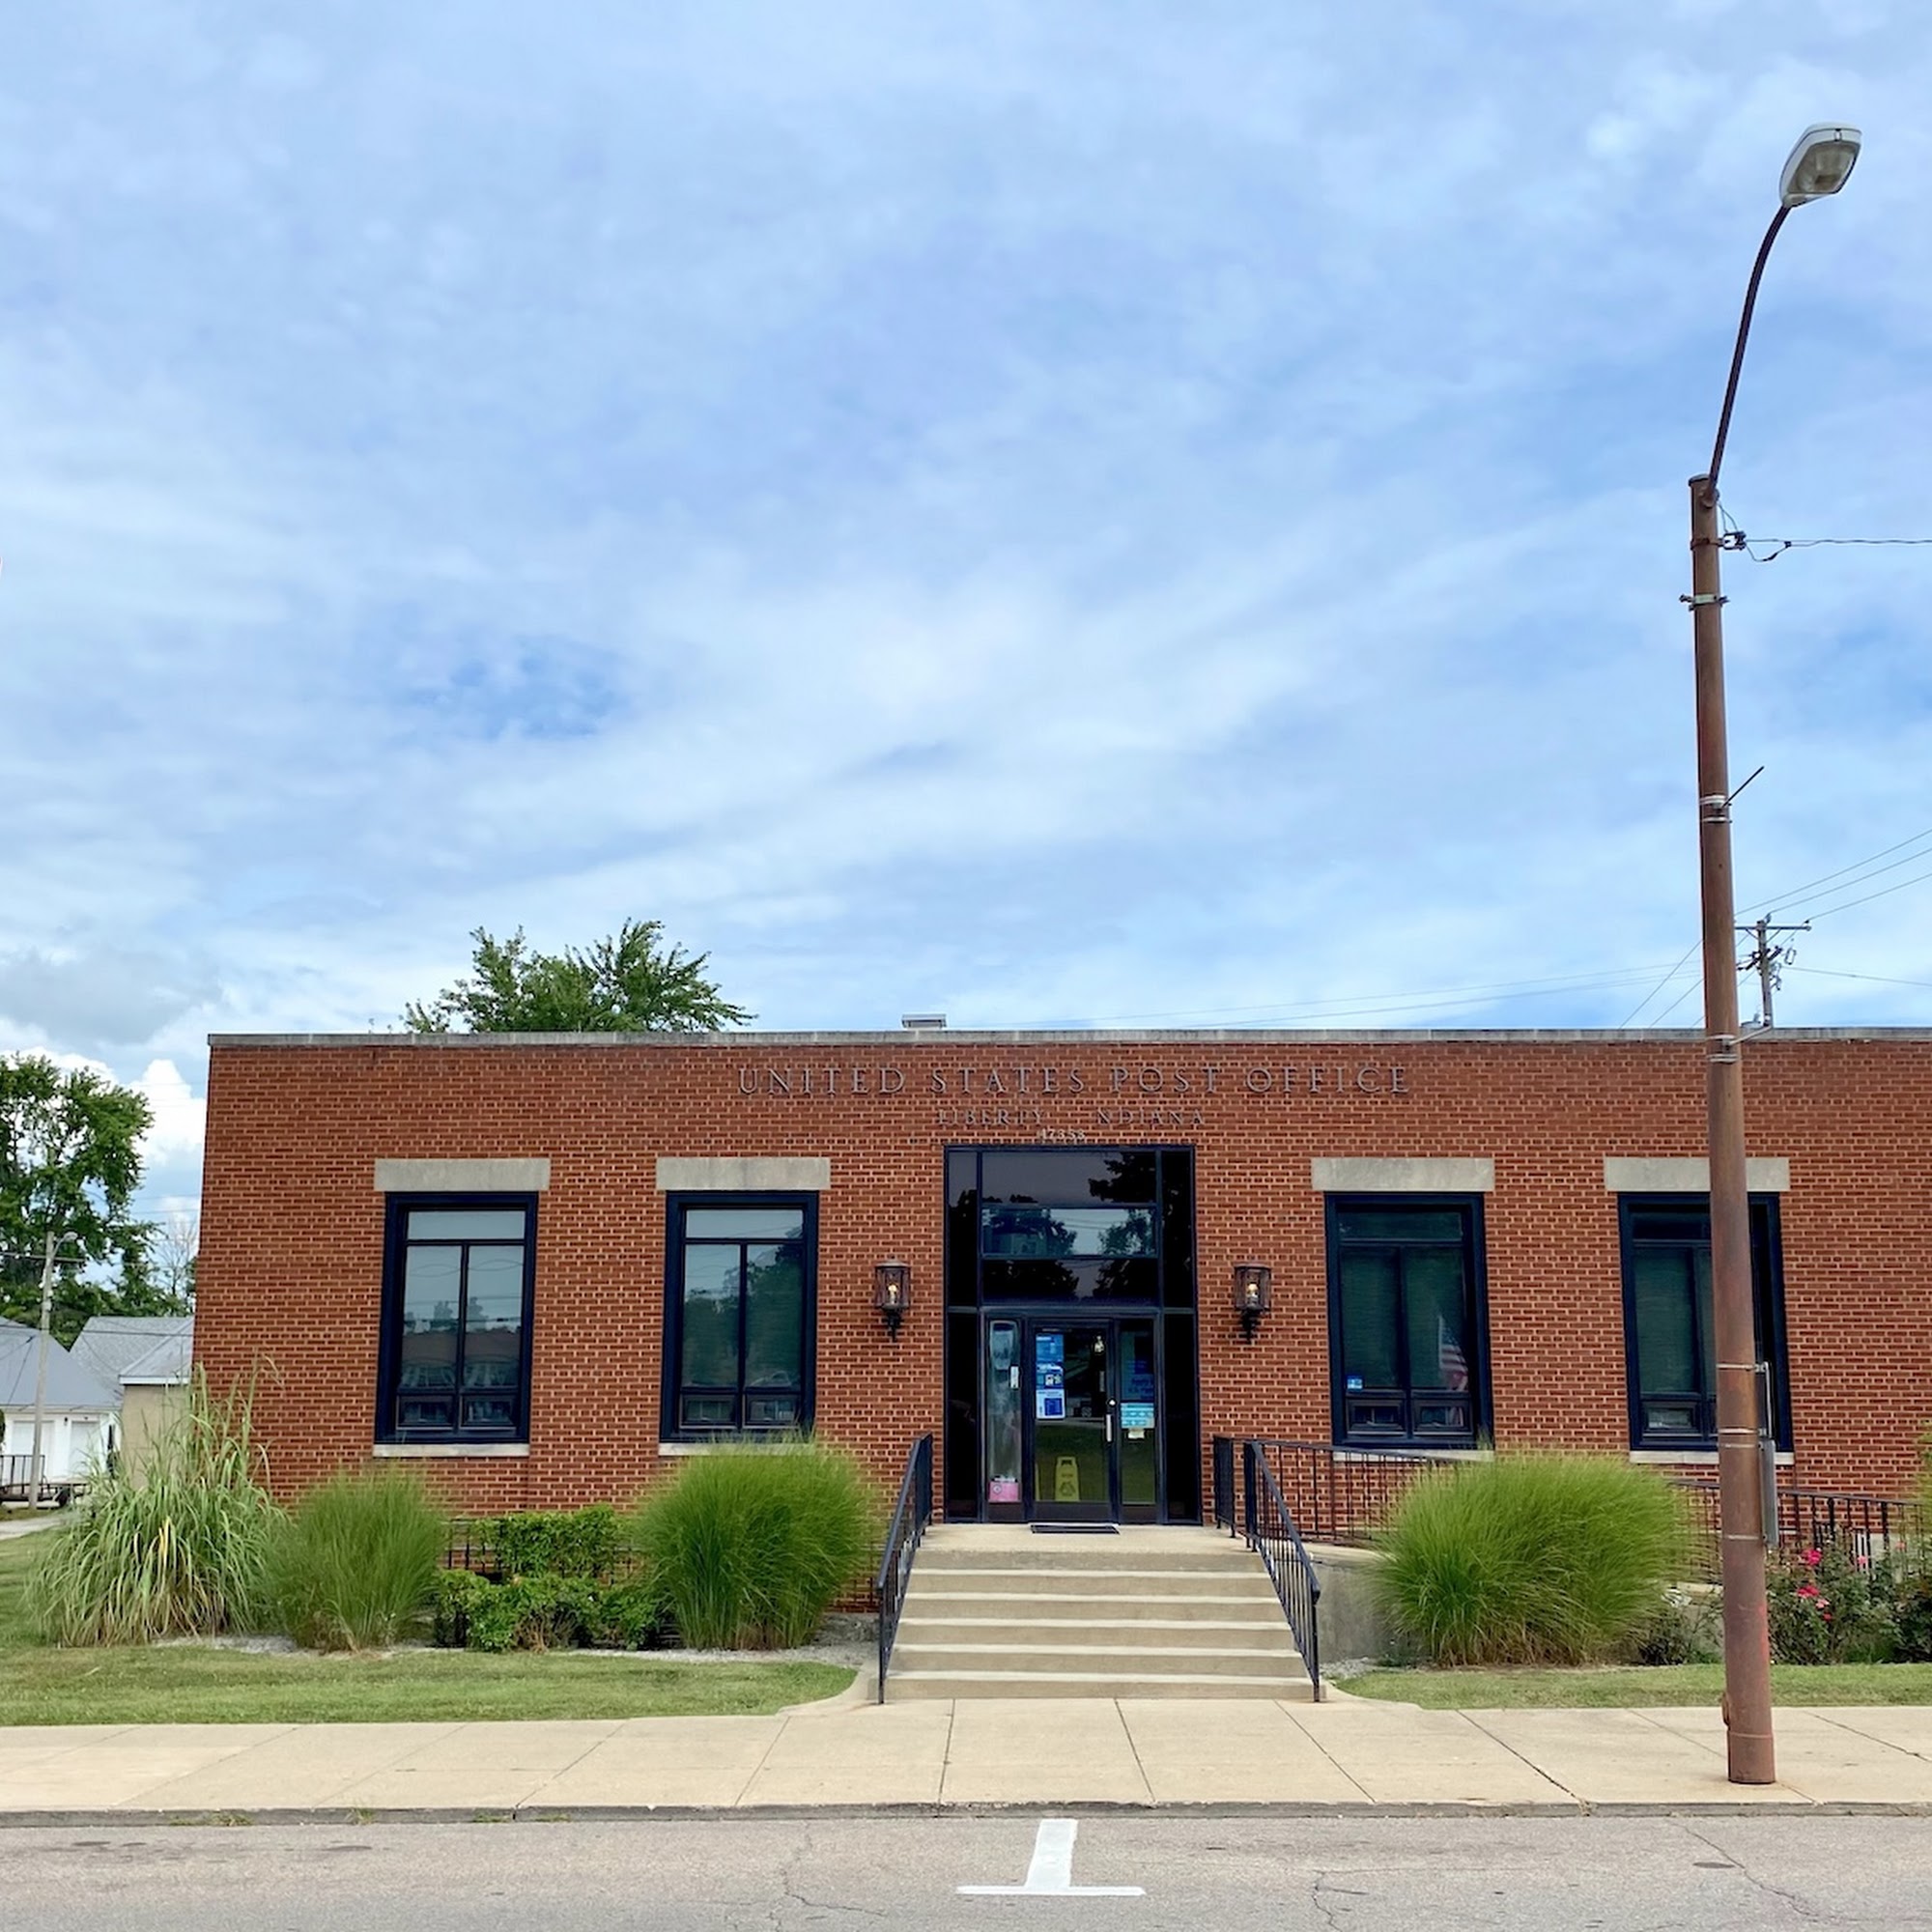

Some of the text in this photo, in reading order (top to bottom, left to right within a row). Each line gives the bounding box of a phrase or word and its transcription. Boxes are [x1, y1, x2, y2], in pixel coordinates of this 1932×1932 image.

[738, 1066, 1409, 1094] UNITED STATES POST OFFICE
